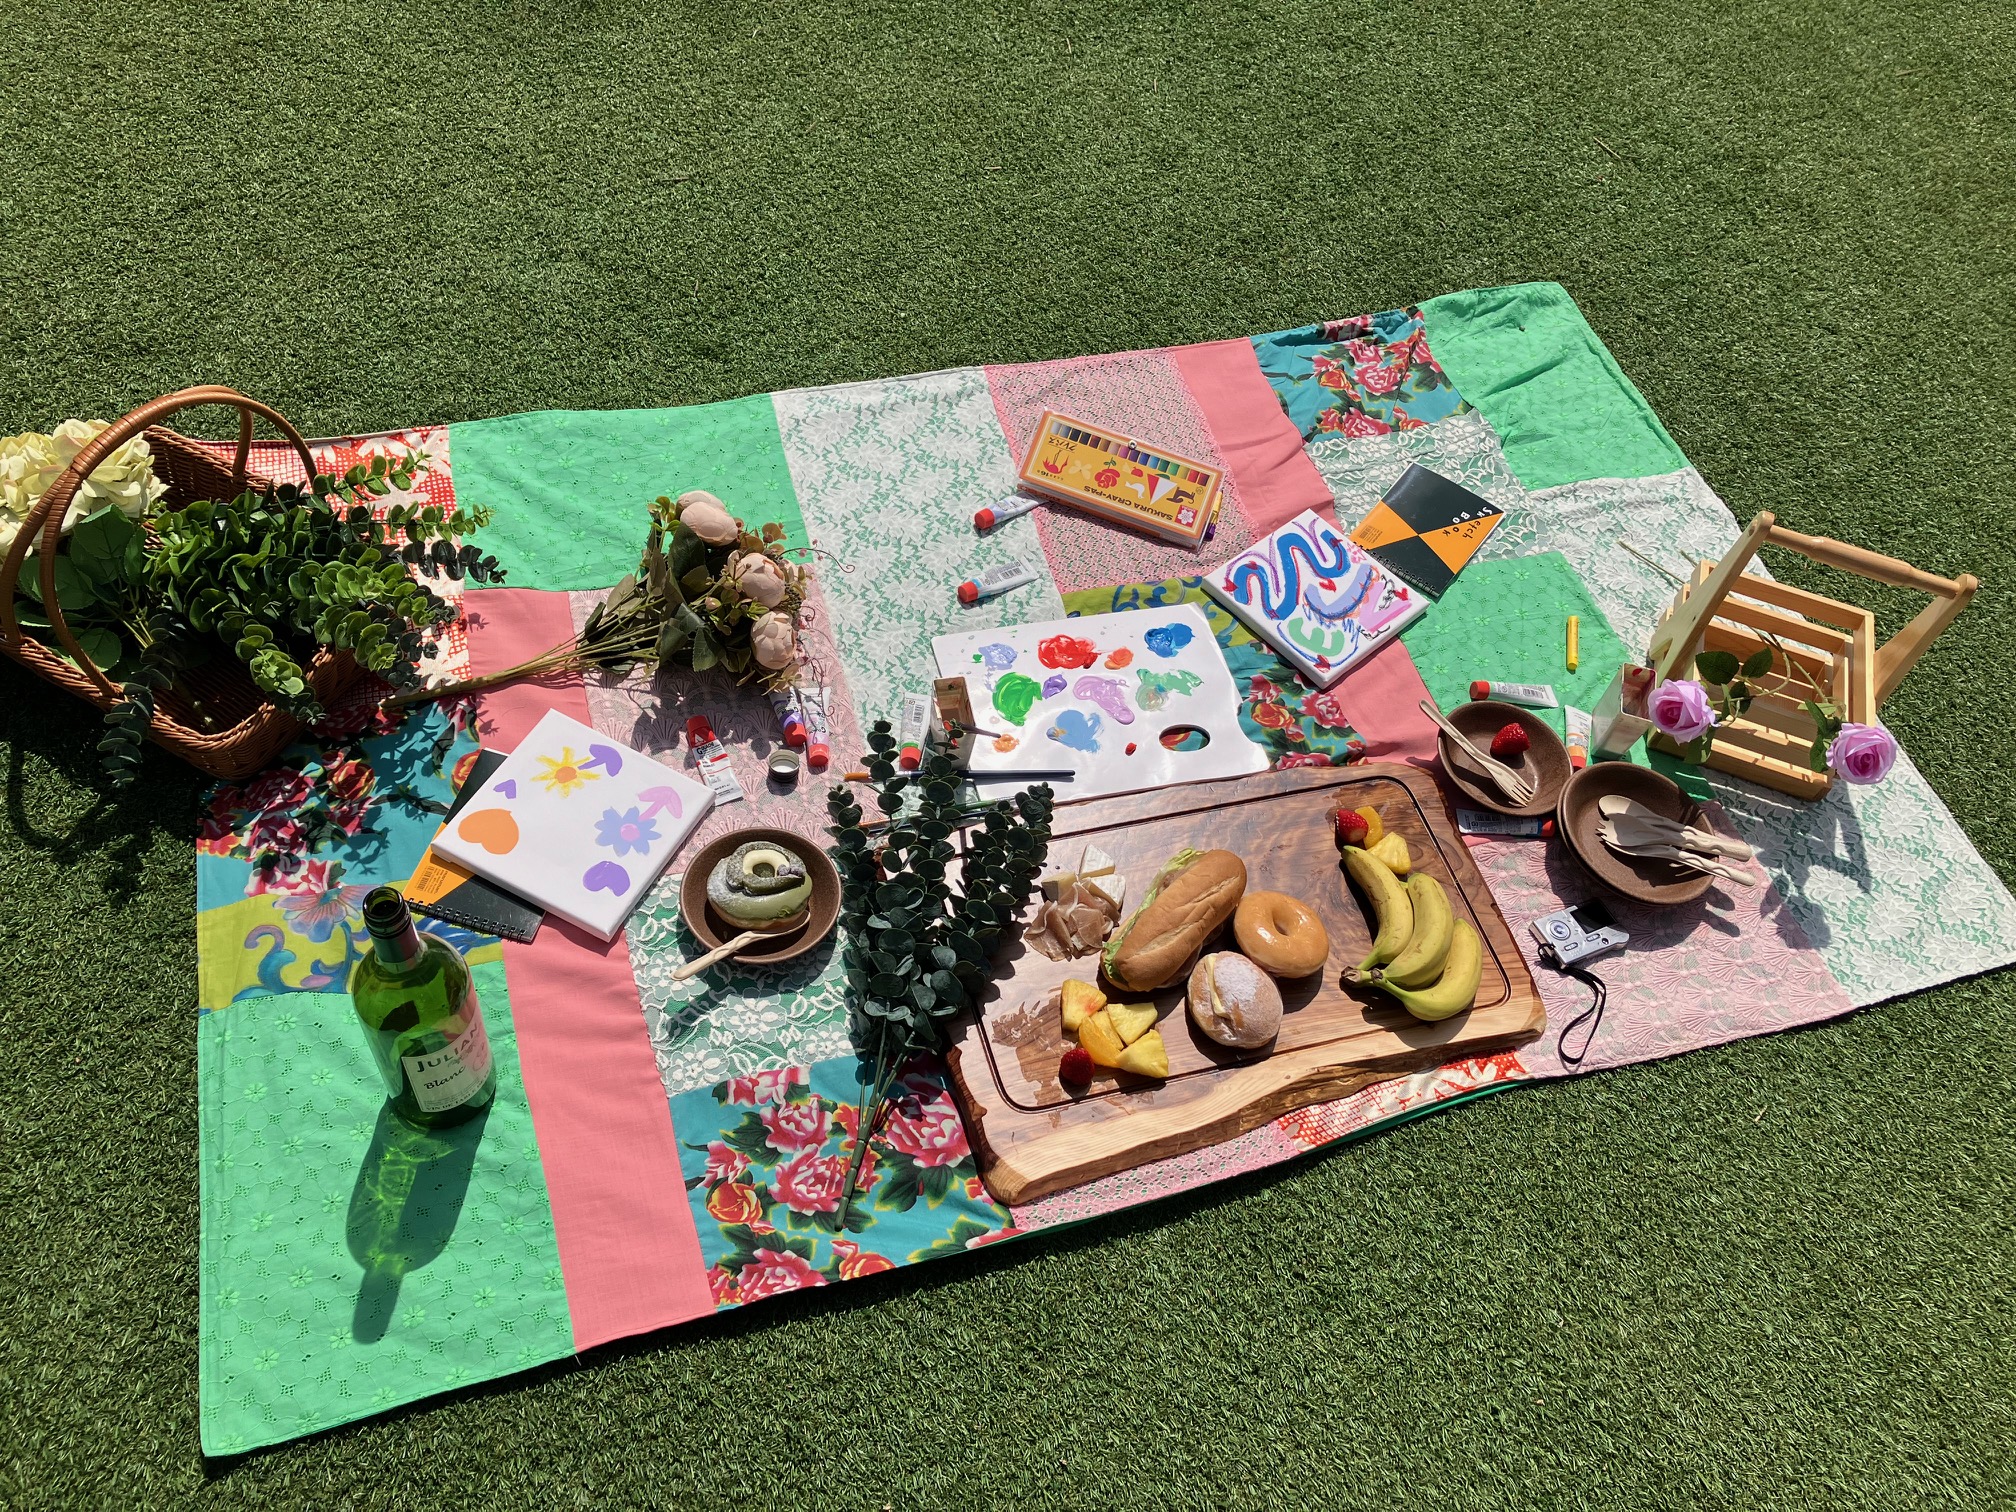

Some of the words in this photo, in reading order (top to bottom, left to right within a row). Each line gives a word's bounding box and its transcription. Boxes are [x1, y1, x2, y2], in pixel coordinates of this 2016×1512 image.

[1083, 485, 1132, 506] CRAY-PAS
[1134, 502, 1174, 521] SAKURA
[417, 1022, 478, 1073] JULIAN
[423, 1065, 467, 1090] Blanc
